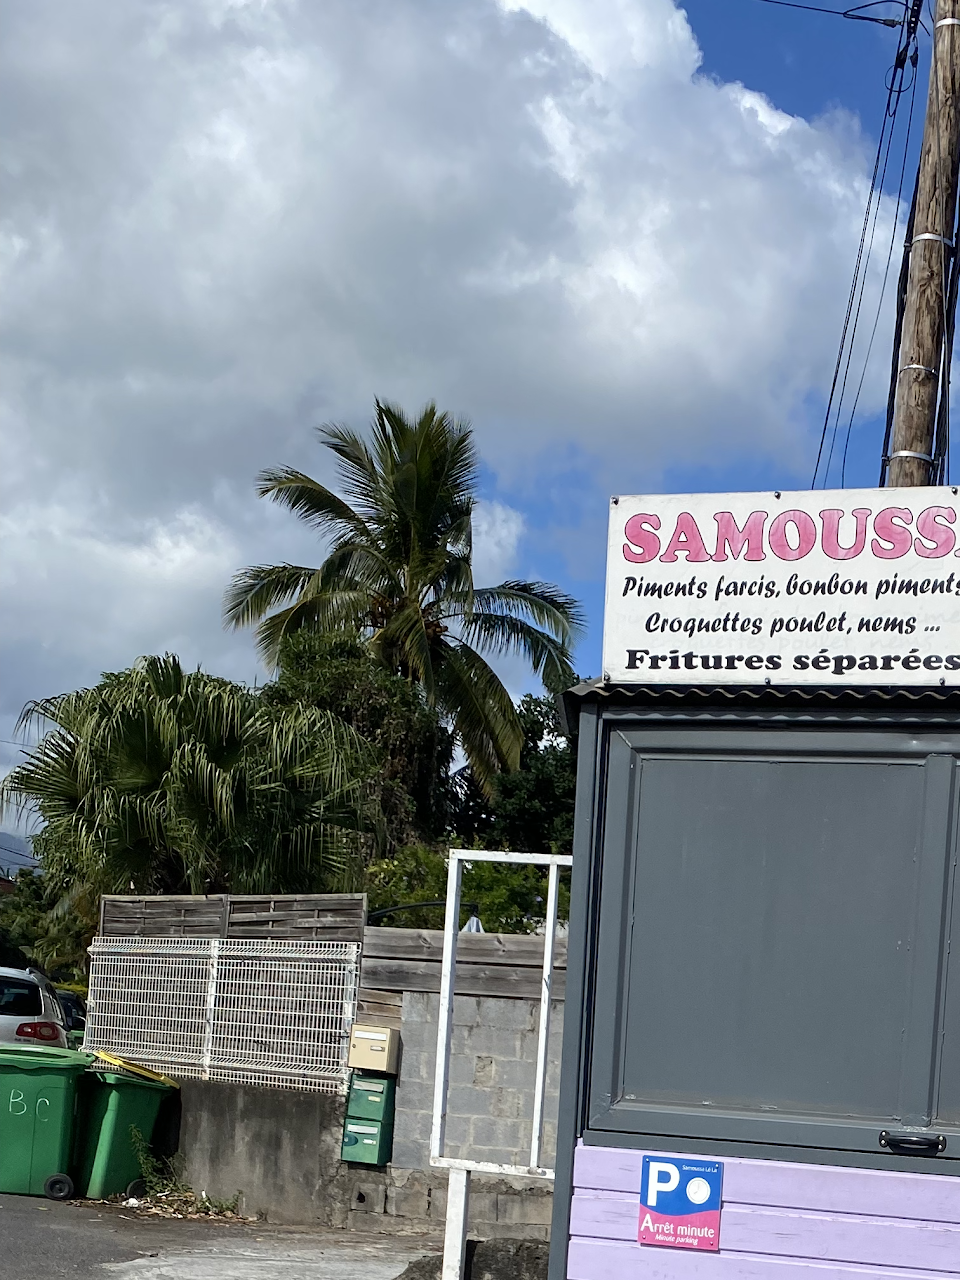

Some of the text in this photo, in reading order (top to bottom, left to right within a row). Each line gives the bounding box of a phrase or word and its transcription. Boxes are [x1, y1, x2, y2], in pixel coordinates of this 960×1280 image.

[622, 576, 708, 599] Piments
[714, 574, 780, 600] farcis,
[785, 573, 868, 595] bonbon
[645, 612, 763, 637] Croquettes
[770, 612, 852, 637] poulet,
[857, 617, 917, 633] nems
[625, 649, 782, 670] Fritures
[647, 1162, 680, 1206] P
[641, 1214, 715, 1237] Arrêt minute
[655, 1234, 698, 1245] Minute parking
